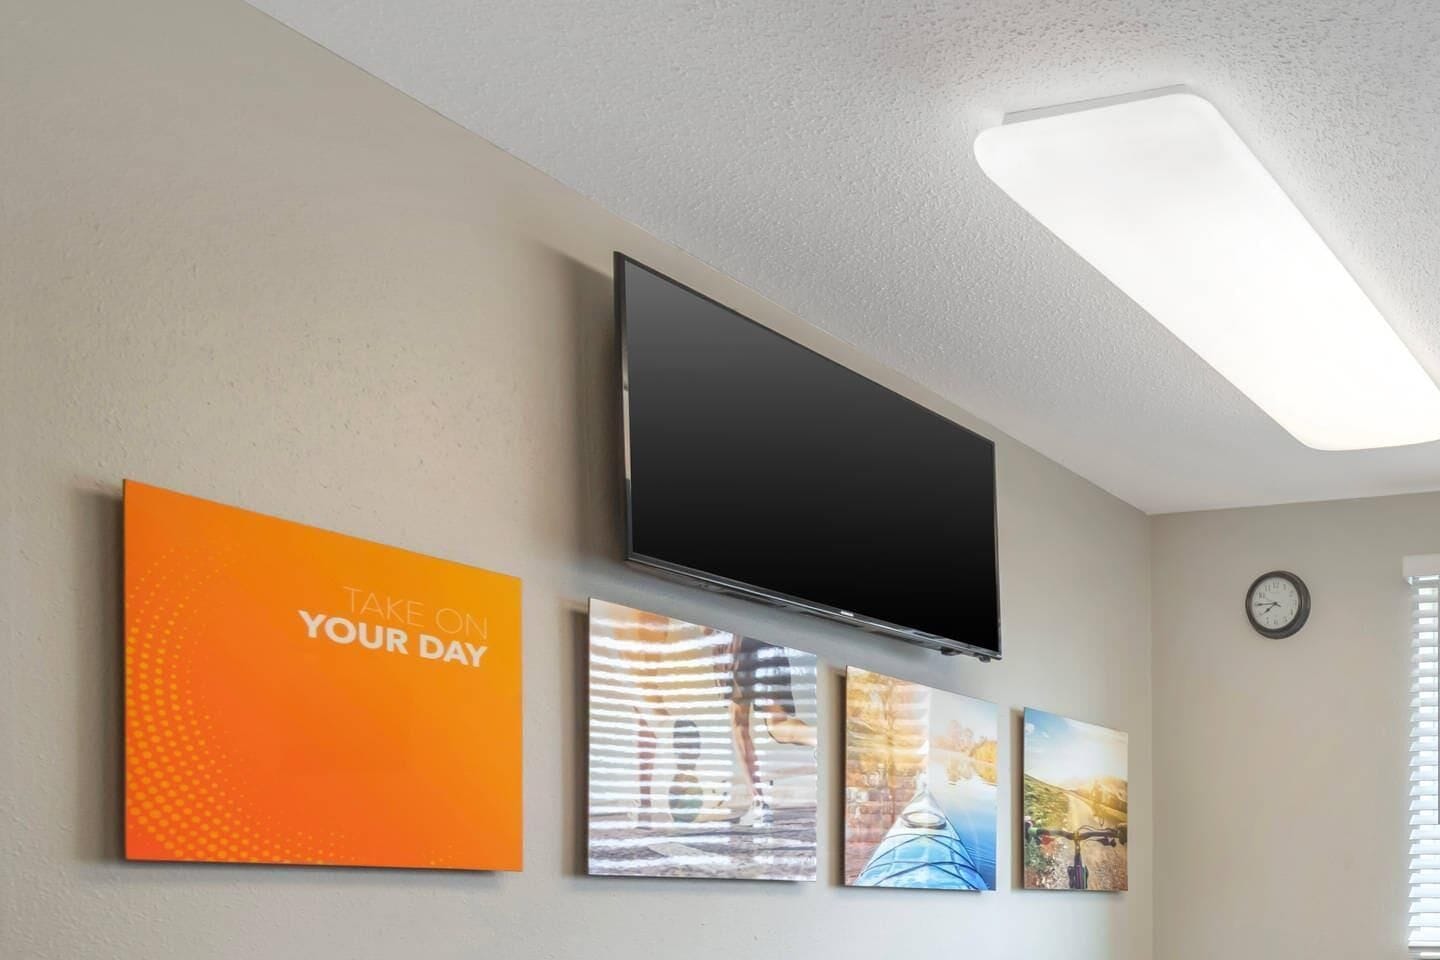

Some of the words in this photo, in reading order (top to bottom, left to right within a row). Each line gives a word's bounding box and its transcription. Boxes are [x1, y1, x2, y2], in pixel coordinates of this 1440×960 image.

[298, 609, 409, 656] YOUR
[419, 635, 488, 667] DAY
[343, 586, 426, 628] TAKE
[436, 607, 489, 640] ON
